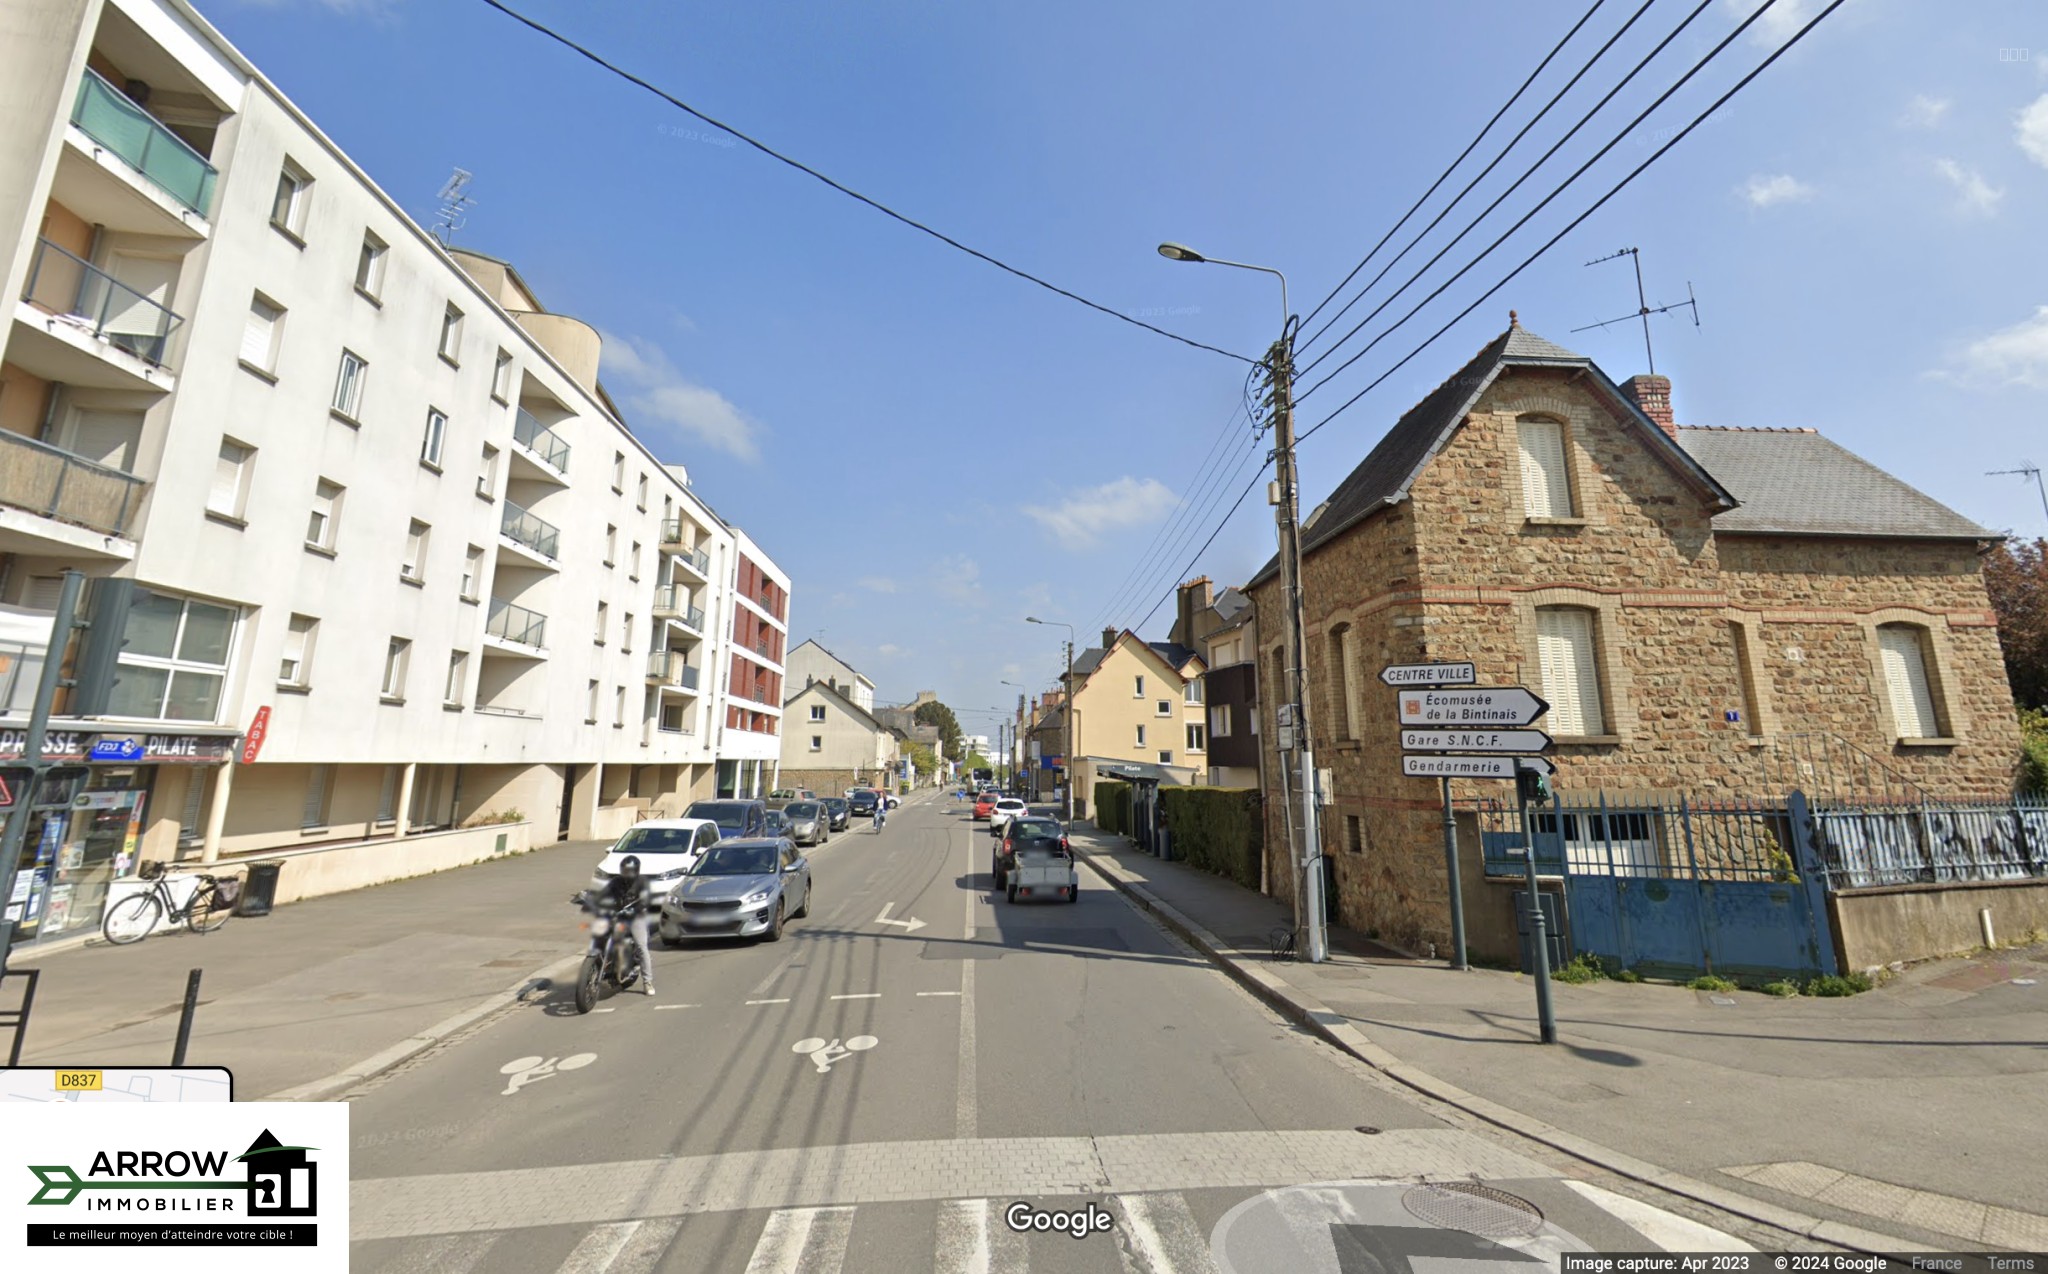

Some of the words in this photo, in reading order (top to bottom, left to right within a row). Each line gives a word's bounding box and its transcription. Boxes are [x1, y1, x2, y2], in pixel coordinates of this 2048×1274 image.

[1388, 669, 1433, 681] CENTRE
[1438, 667, 1470, 680] VILLE
[1426, 692, 1492, 706] Écomusée
[1426, 708, 1441, 720] de
[1446, 709, 1457, 720] la
[1462, 708, 1518, 720] Bintinais
[0, 730, 79, 754] PRSSE
[244, 710, 267, 760] TABAC
[1407, 734, 1439, 746] Gare
[1447, 734, 1503, 747] S.N.C.F.
[98, 742, 120, 752] FDJ
[147, 736, 199, 756] PILATE
[1409, 759, 1500, 773] Gendarmerie
